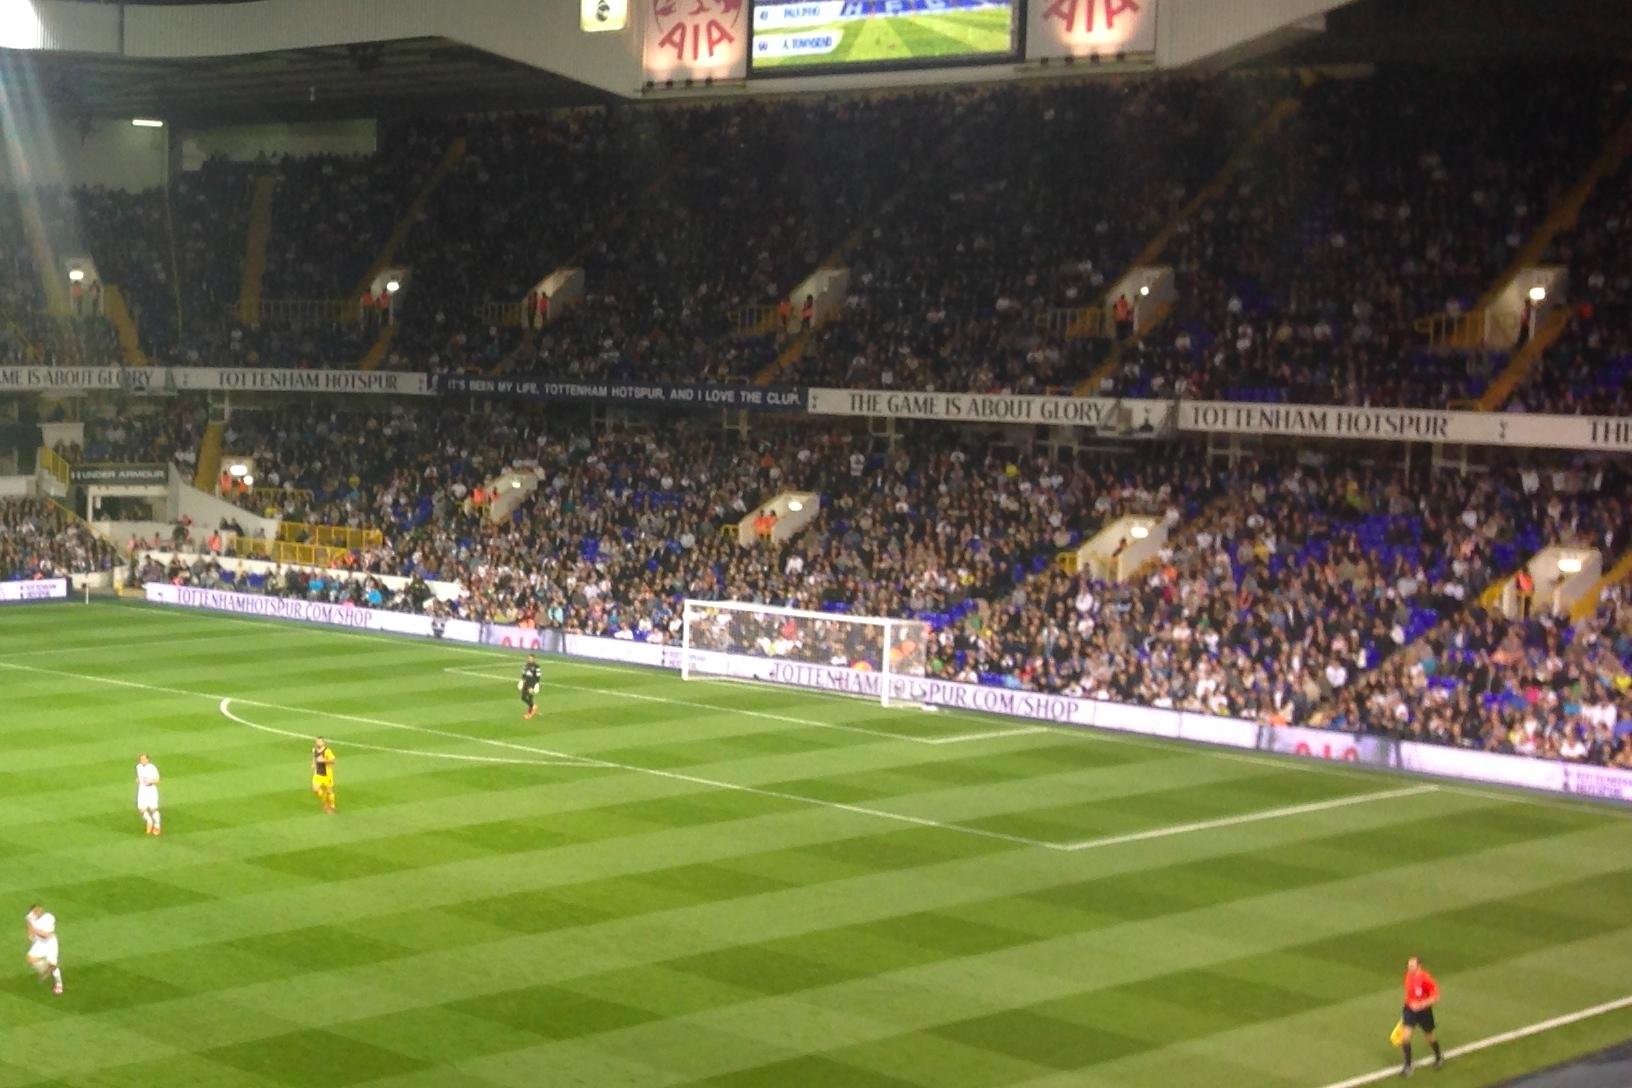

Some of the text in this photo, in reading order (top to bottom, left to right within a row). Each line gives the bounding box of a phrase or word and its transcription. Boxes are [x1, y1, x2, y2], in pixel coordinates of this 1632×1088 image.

[1043, 0, 1139, 32] AIA
[658, 19, 735, 60] AIA
[28, 369, 41, 386] IS
[46, 369, 94, 386] ABOUT
[218, 371, 400, 391] TOTTENHAM HOTSPUR
[447, 379, 466, 391] IT'S
[469, 380, 494, 392] BEEN
[497, 381, 513, 393] MY
[544, 383, 607, 398] TOTTENHAM
[669, 388, 694, 400] AND
[705, 390, 735, 402] LOVE
[739, 391, 762, 403] THE
[848, 393, 1106, 422] THE GAME IS ABOUT GLORY
[1192, 406, 1449, 437] TOTTENHAM HOTSPUR
[82, 470, 165, 480] UNDER ARMOUR
[177, 588, 372, 627] TOTTENHAMHOTSPUR.COM/SHOP
